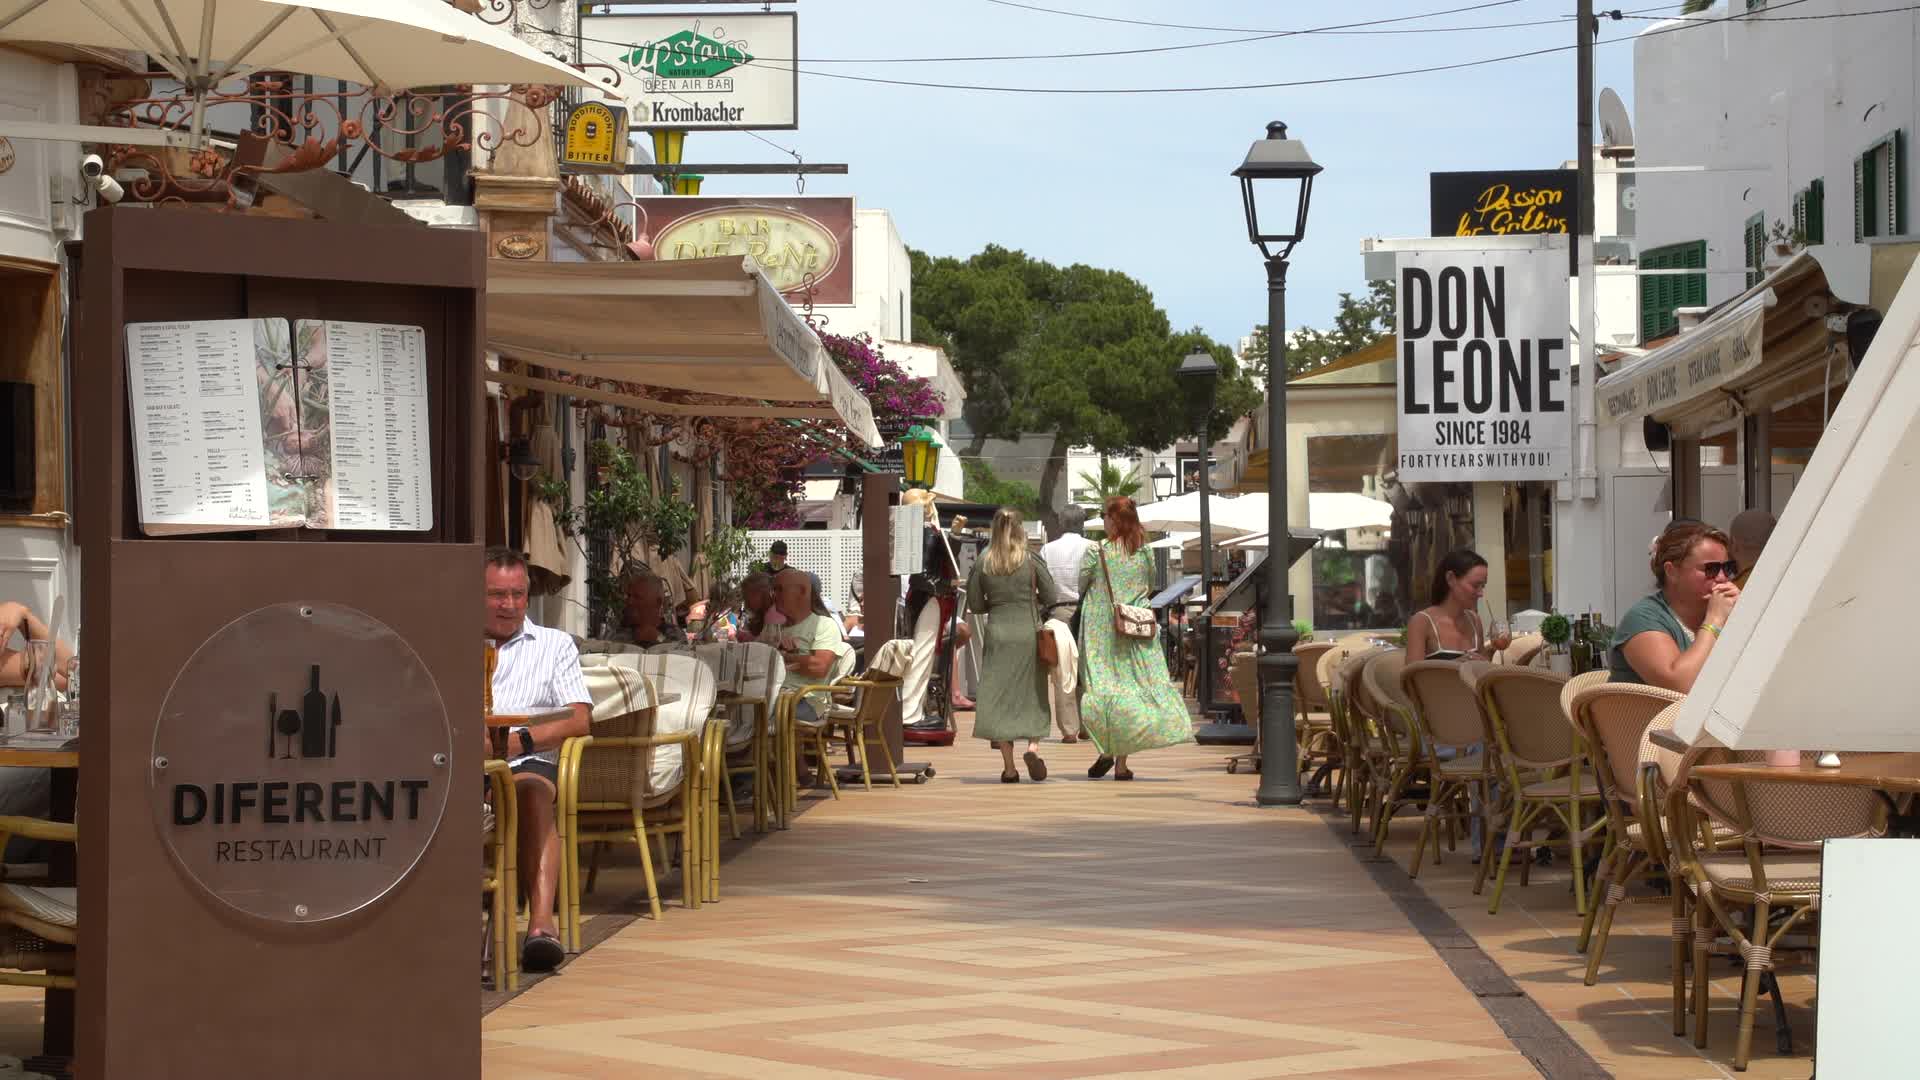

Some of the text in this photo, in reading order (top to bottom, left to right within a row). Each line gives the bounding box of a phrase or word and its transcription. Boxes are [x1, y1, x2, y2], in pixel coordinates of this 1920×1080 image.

[645, 79, 731, 90] OPEN AIR BAR
[652, 101, 745, 122] Krombacher
[567, 152, 609, 161] BITTER
[719, 216, 769, 237] BAR
[1402, 266, 1506, 340] DON
[1403, 338, 1565, 415] LEONE
[1435, 419, 1531, 446] SINCE 1984
[1401, 452, 1551, 468] FORTYYEARSWITHYOU!
[173, 780, 429, 826] DIFERENT
[215, 838, 387, 862] RESTAURANT
